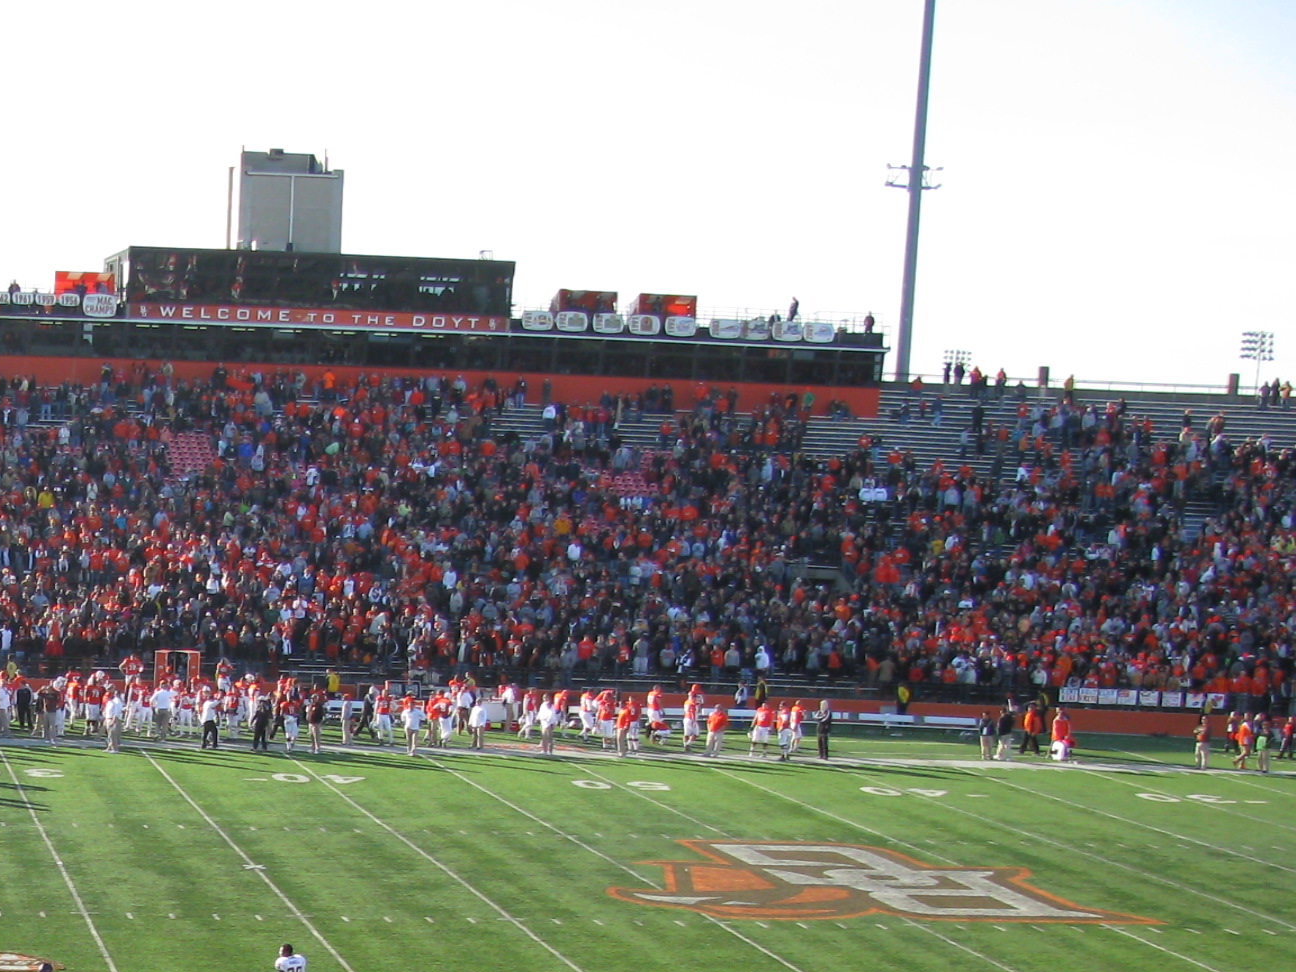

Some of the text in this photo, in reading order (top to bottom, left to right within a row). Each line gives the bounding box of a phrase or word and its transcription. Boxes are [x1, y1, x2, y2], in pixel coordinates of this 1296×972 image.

[15, 293, 33, 304] 1961
[97, 296, 112, 304] MAC
[85, 304, 115, 314] CHAMPS
[160, 306, 479, 329] WELCOME TO THE DOYT
